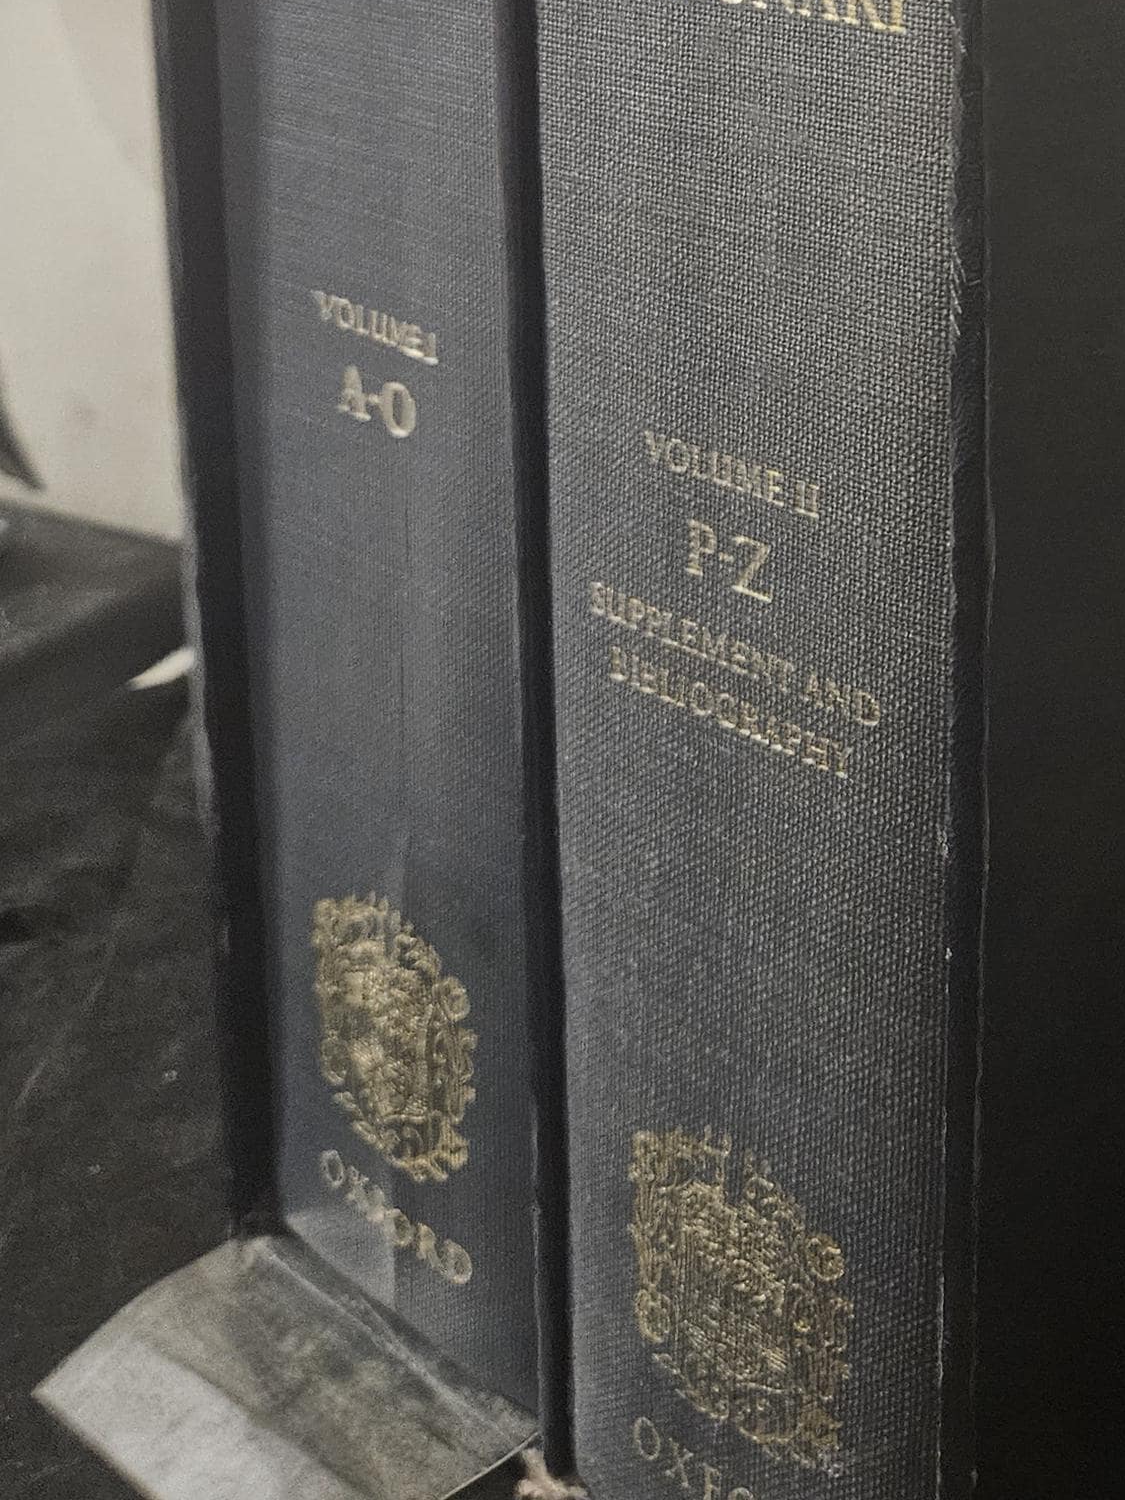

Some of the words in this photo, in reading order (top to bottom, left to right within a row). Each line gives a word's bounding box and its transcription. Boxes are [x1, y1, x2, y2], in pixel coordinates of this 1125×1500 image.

[310, 290, 424, 358] VOLUME
[644, 430, 783, 507] VOLUME
[686, 519, 772, 601] P-Z
[802, 672, 880, 727] AND
[320, 1149, 473, 1284] OXFORD
[633, 1416, 755, 1500] OXF
